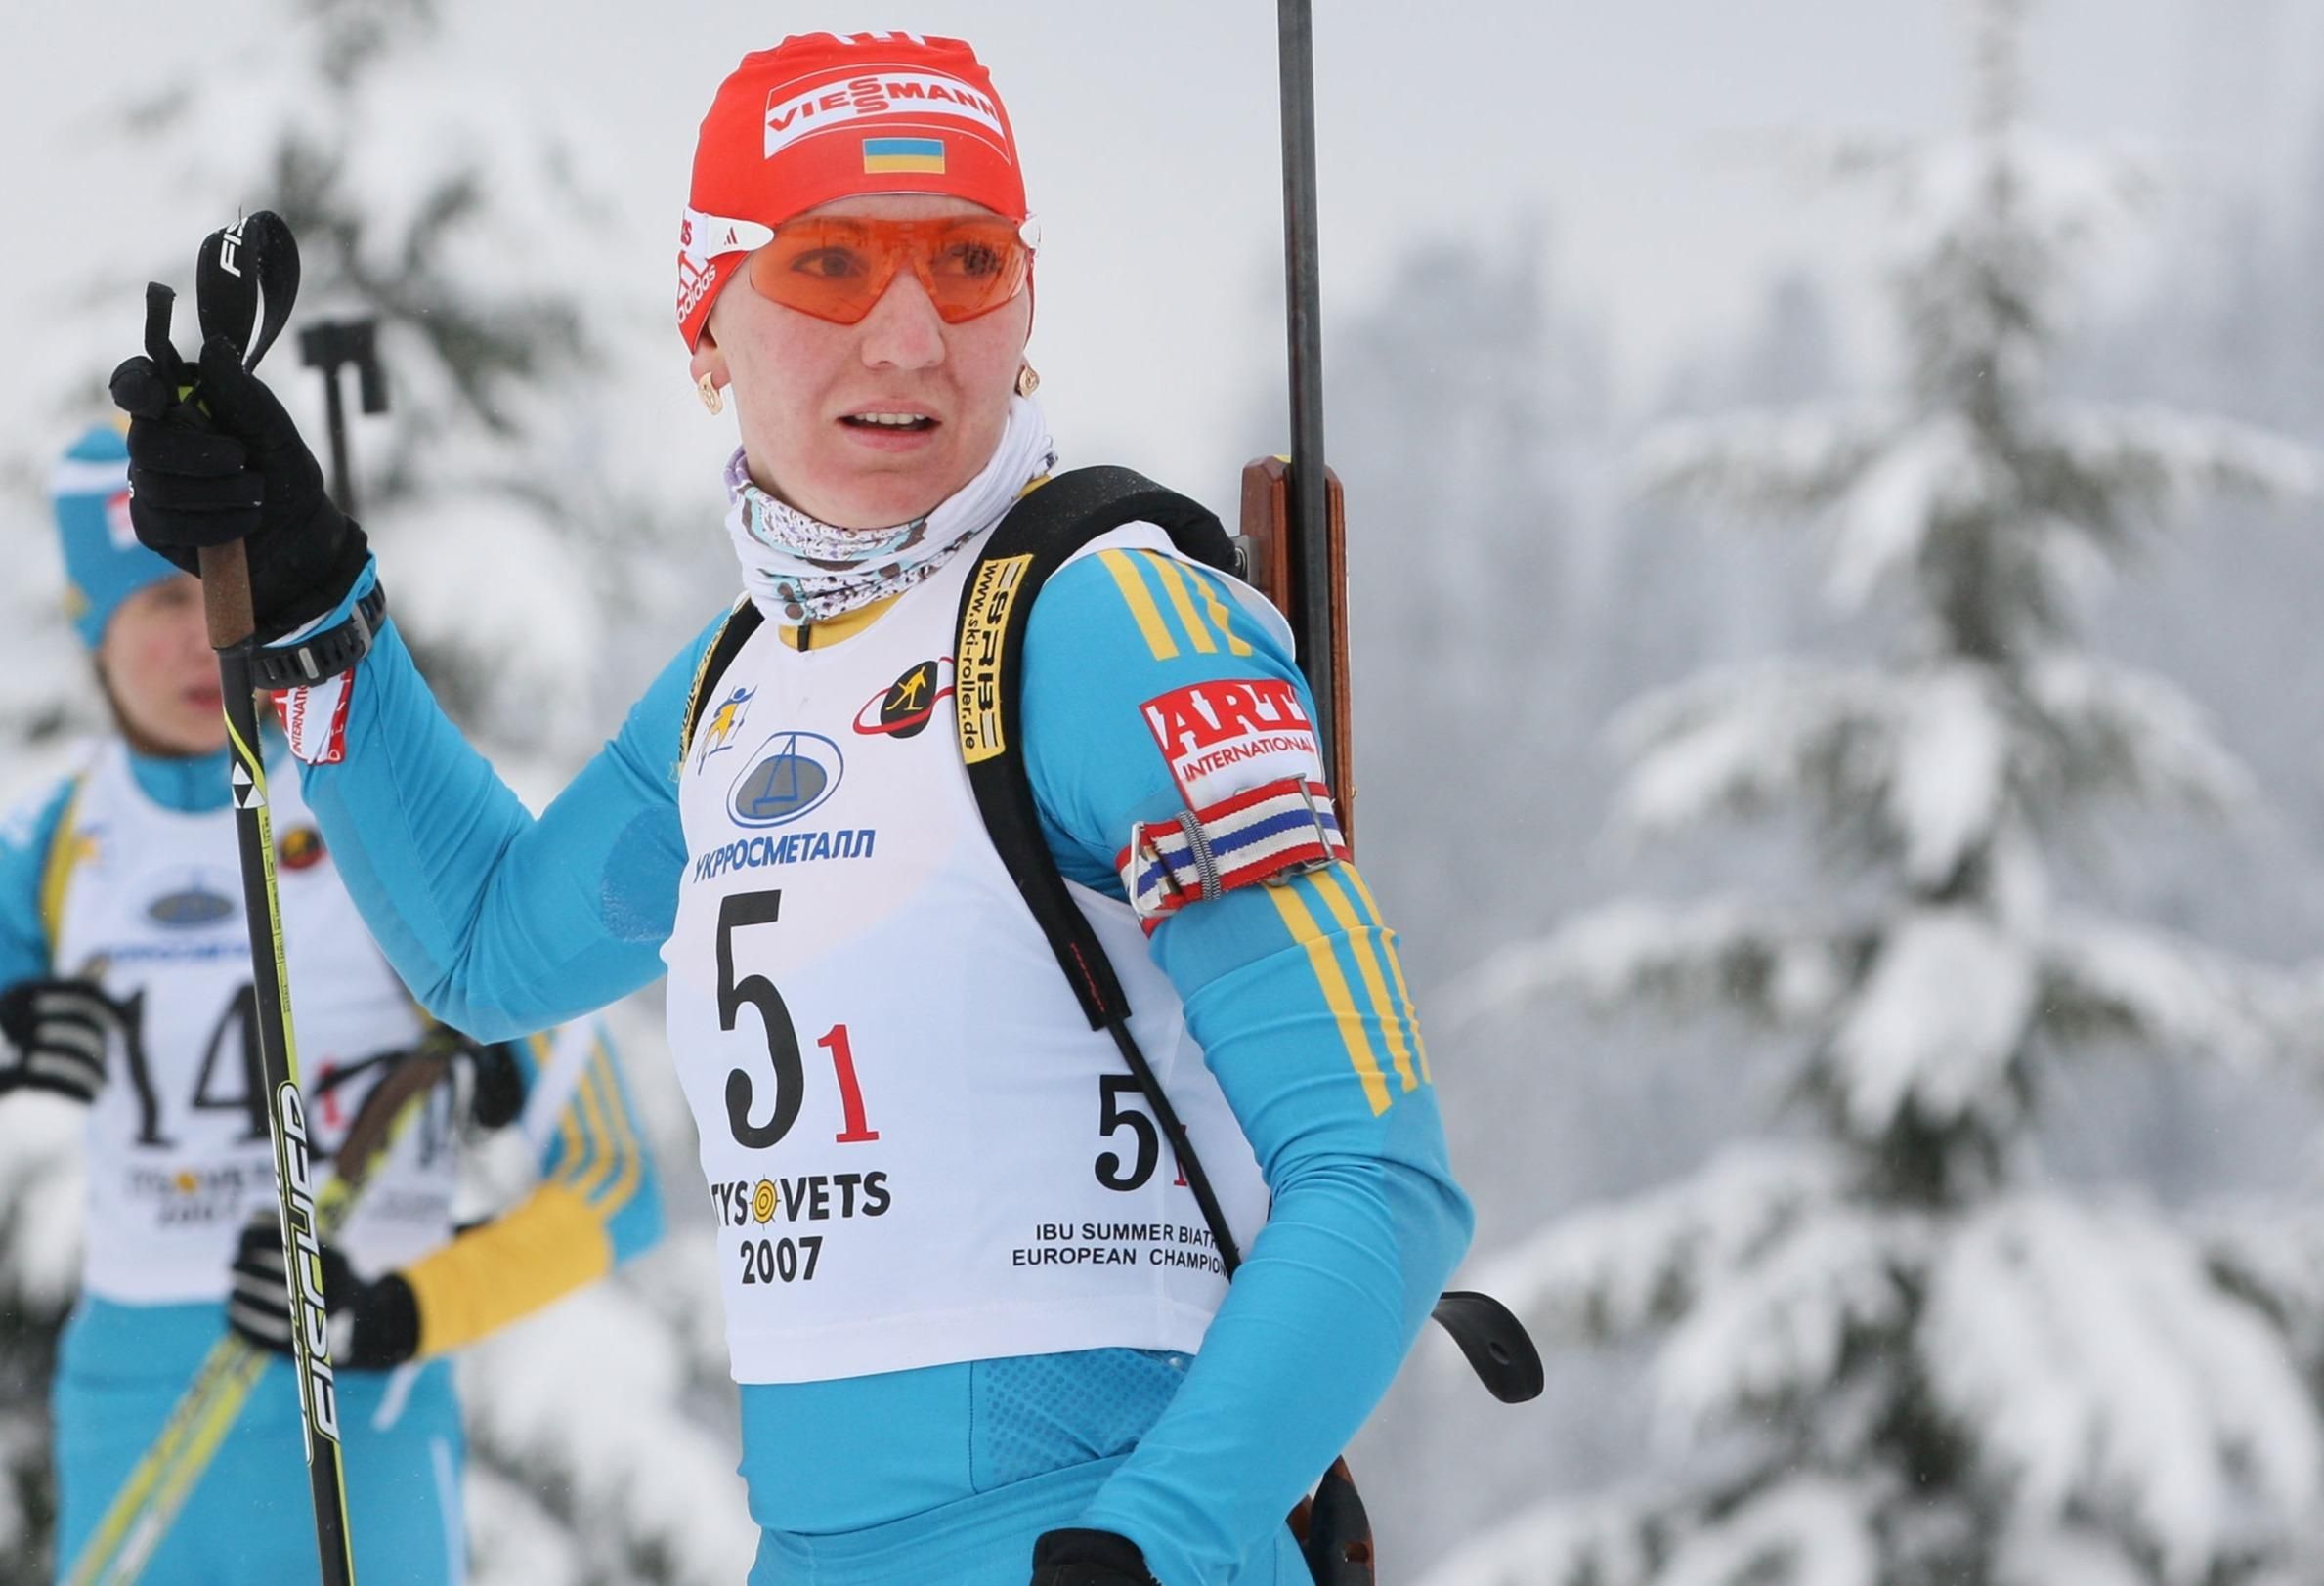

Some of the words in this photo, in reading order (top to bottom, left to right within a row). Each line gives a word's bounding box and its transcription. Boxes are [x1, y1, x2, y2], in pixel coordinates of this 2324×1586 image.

[767, 77, 996, 132] VIESSMANN
[677, 263, 716, 324] adidas
[962, 562, 999, 750] www.ski-roller.de
[1183, 737, 1315, 782] INTERNATIONAL
[693, 830, 875, 883] УКРРОСМЕТАЛЛ
[716, 889, 804, 1149] 5
[817, 1024, 880, 1142] 1
[1095, 1074, 1159, 1191] 5
[1012, 1248, 1136, 1266] EUROPEAN
[1036, 1223, 1074, 1241] IBU
[1082, 1223, 1173, 1241] SUMMER
[740, 1236, 823, 1284] 2007
